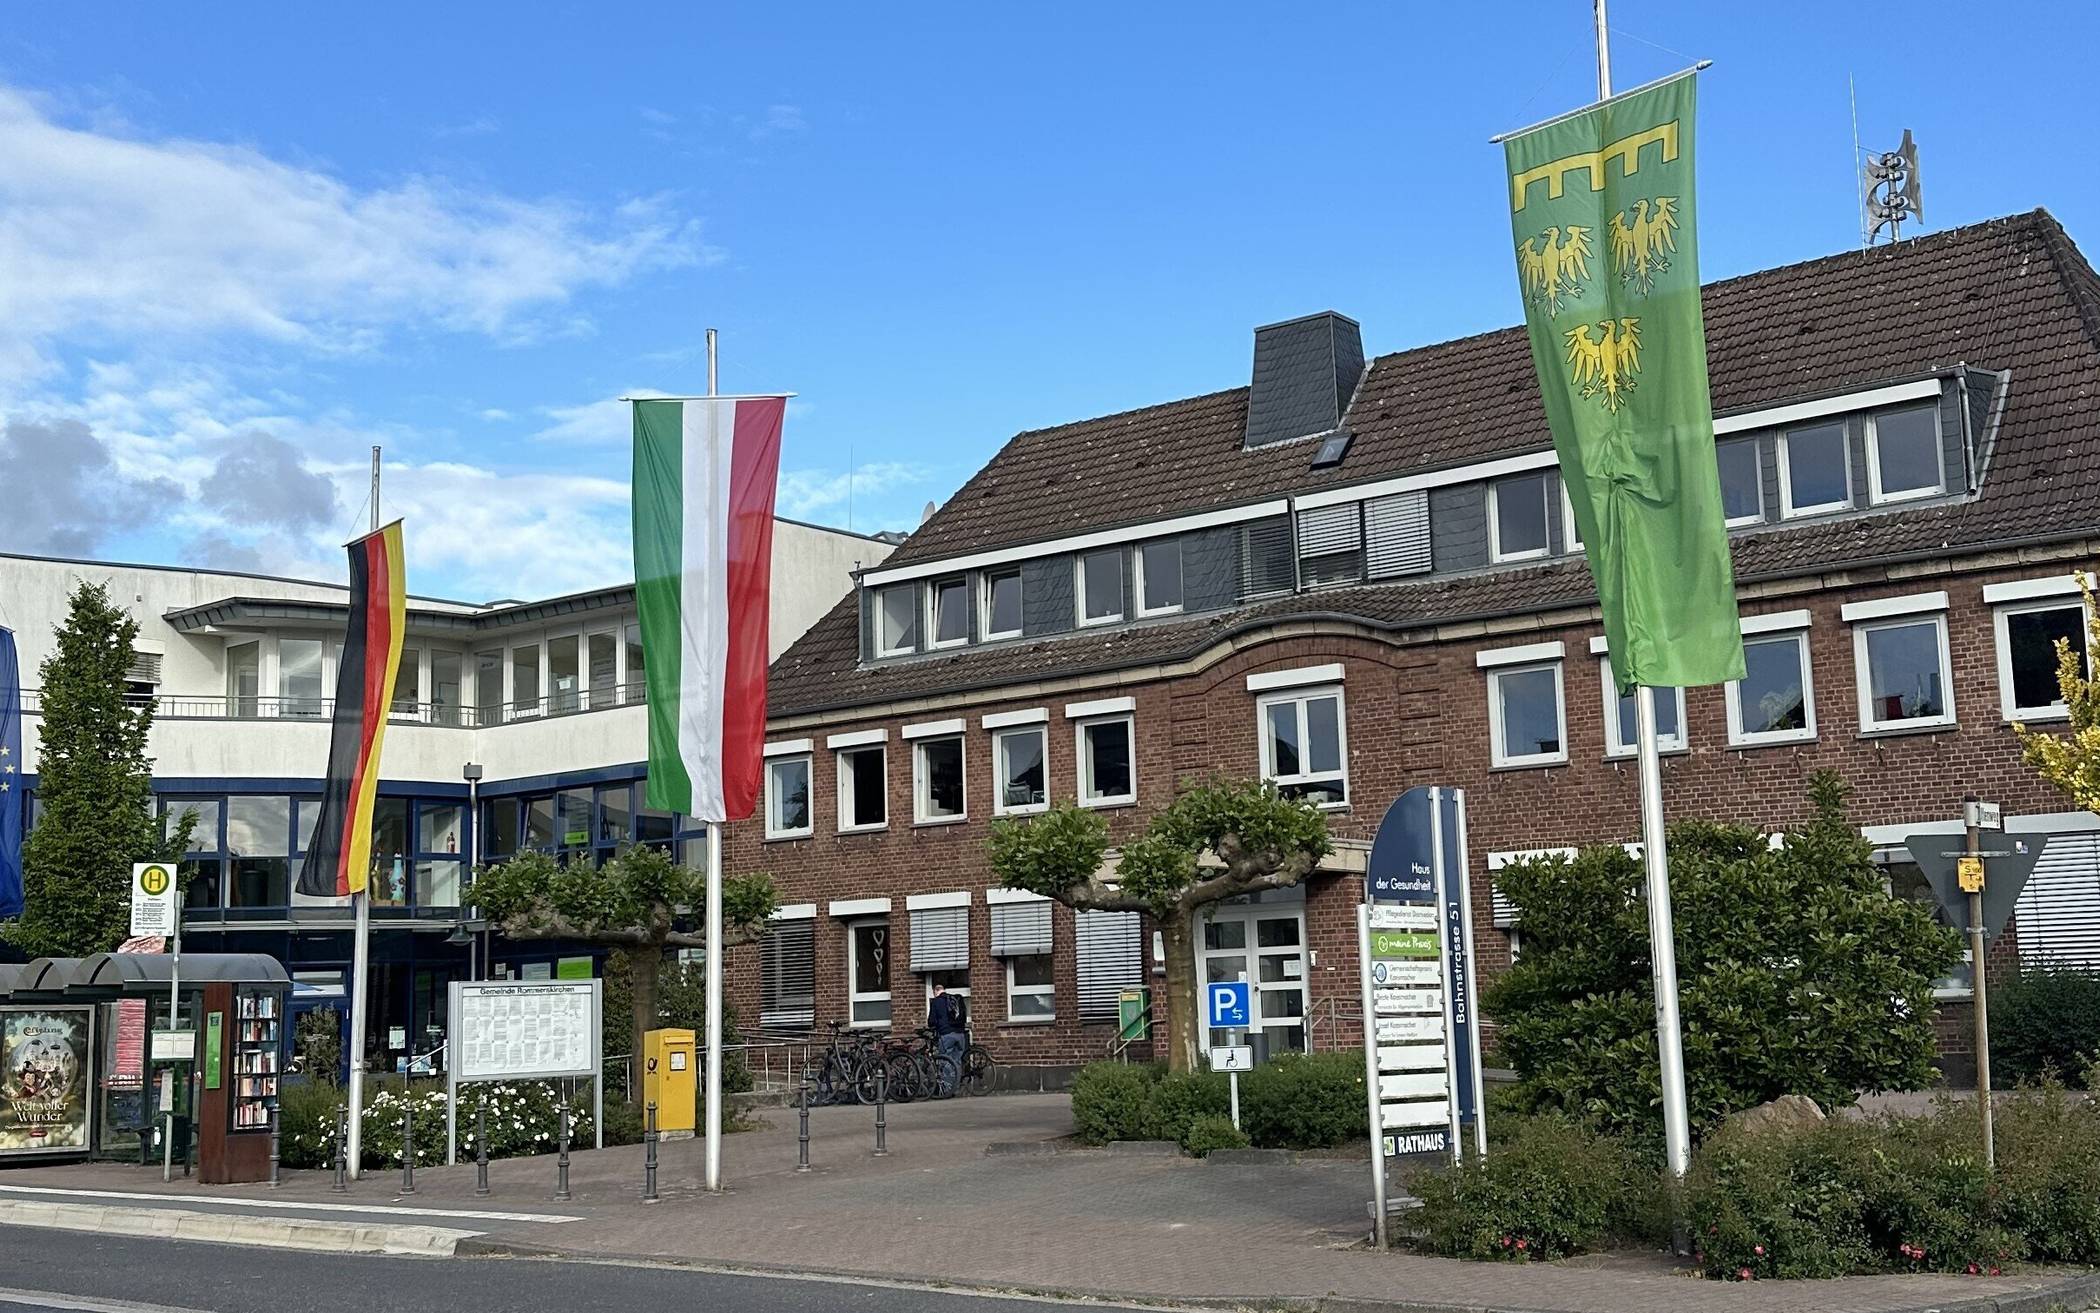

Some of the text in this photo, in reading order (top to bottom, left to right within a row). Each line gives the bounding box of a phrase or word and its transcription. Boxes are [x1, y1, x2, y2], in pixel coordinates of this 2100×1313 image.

[1411, 862, 1430, 874] Haus
[148, 871, 162, 889] H
[1376, 877, 1431, 891] der Gesundheit
[1449, 902, 1466, 1024] Bahnstrasse 51
[480, 986, 575, 995] Gemeinde Rommerskirchen
[1215, 988, 1237, 1021] P
[17, 1112, 63, 1122] Wunder
[1397, 1132, 1445, 1154] RATHAUS
